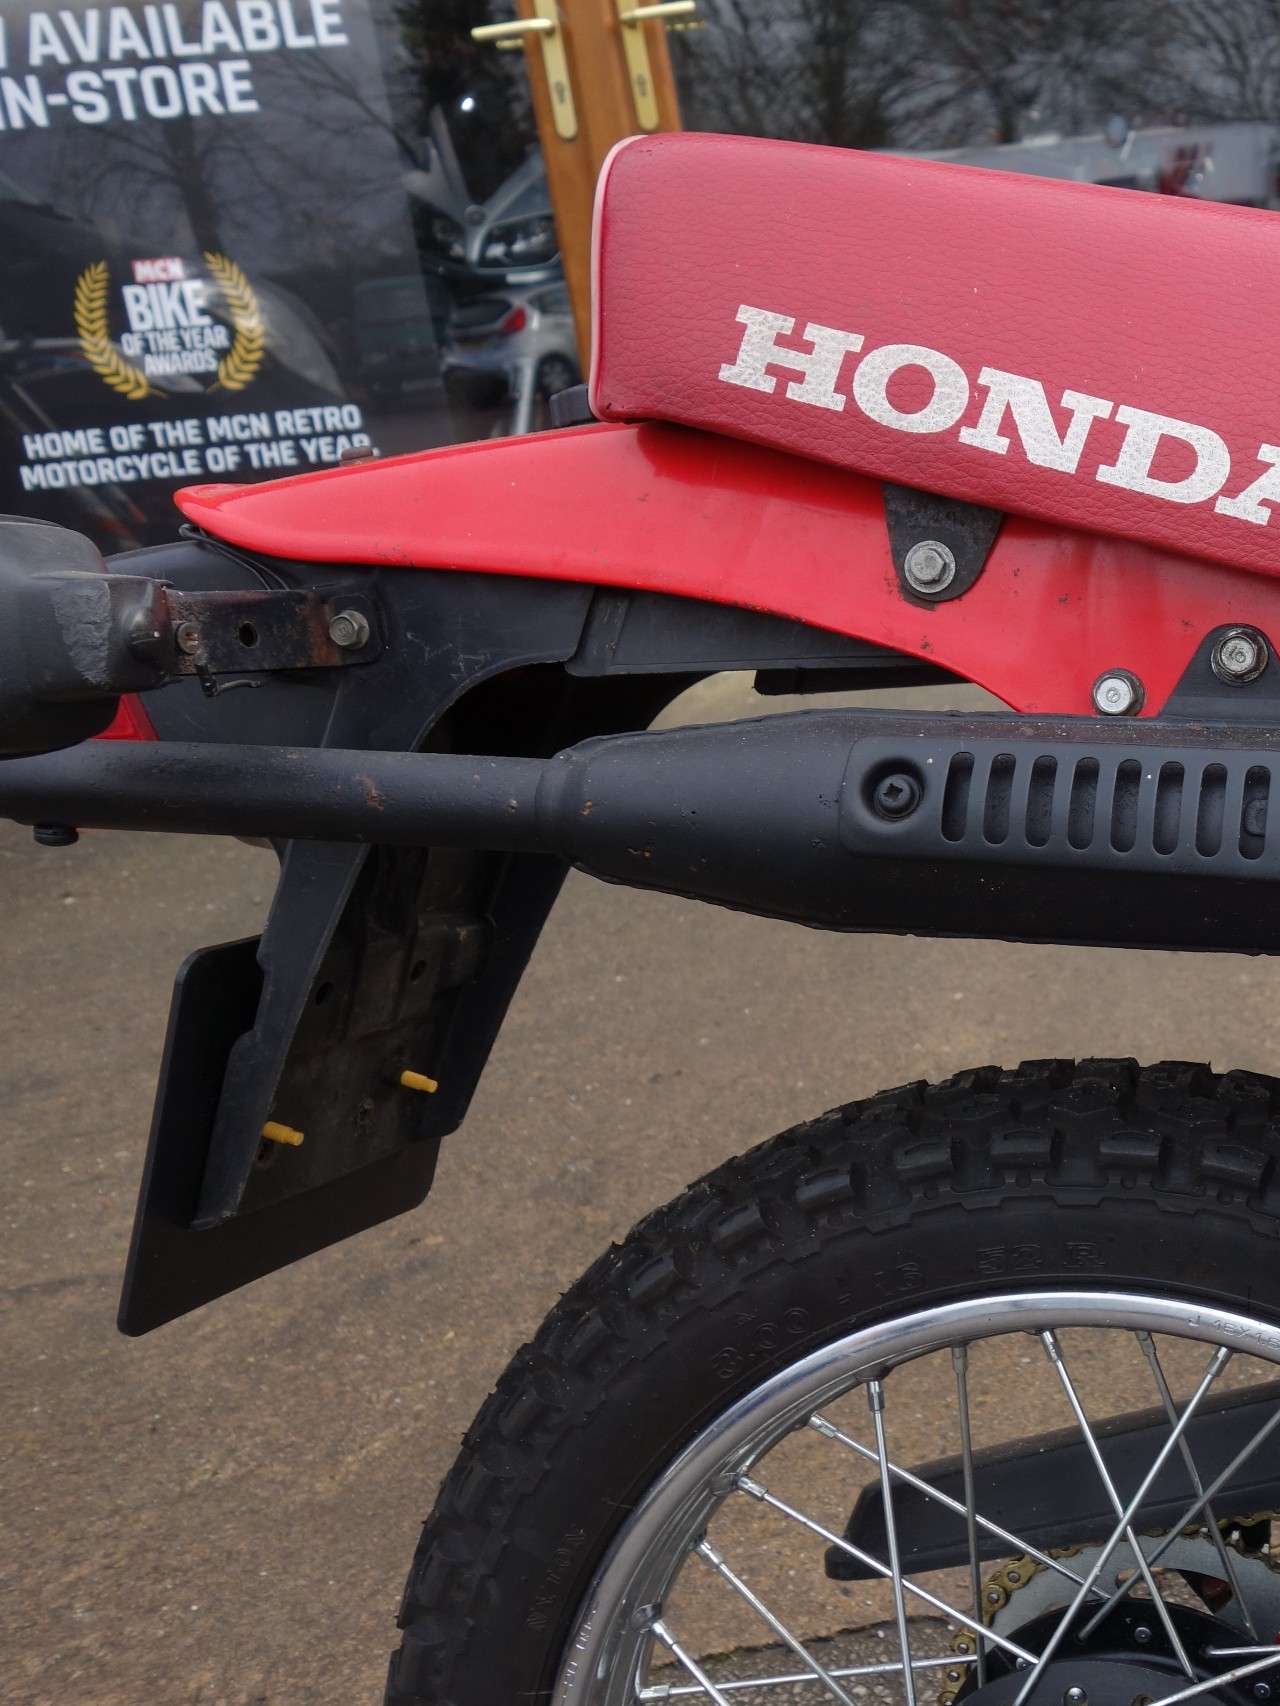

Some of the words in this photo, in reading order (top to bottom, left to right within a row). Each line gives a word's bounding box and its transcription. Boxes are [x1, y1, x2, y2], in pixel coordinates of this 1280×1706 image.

[28, 0, 349, 68] AVAILABLE
[133, 257, 184, 283] MCN
[122, 280, 213, 332] BIKE
[121, 333, 145, 357] OF
[144, 328, 181, 353] THE
[179, 325, 231, 351] YEAR
[144, 347, 218, 377] AWARDS
[23, 429, 105, 461] HOME
[109, 425, 146, 451] OF
[148, 419, 204, 447] THE
[206, 412, 271, 443] MCN
[274, 404, 362, 435] RETRO
[19, 450, 203, 491] MOTORCYCLE
[206, 446, 243, 473] OF
[245, 440, 298, 468] THE
